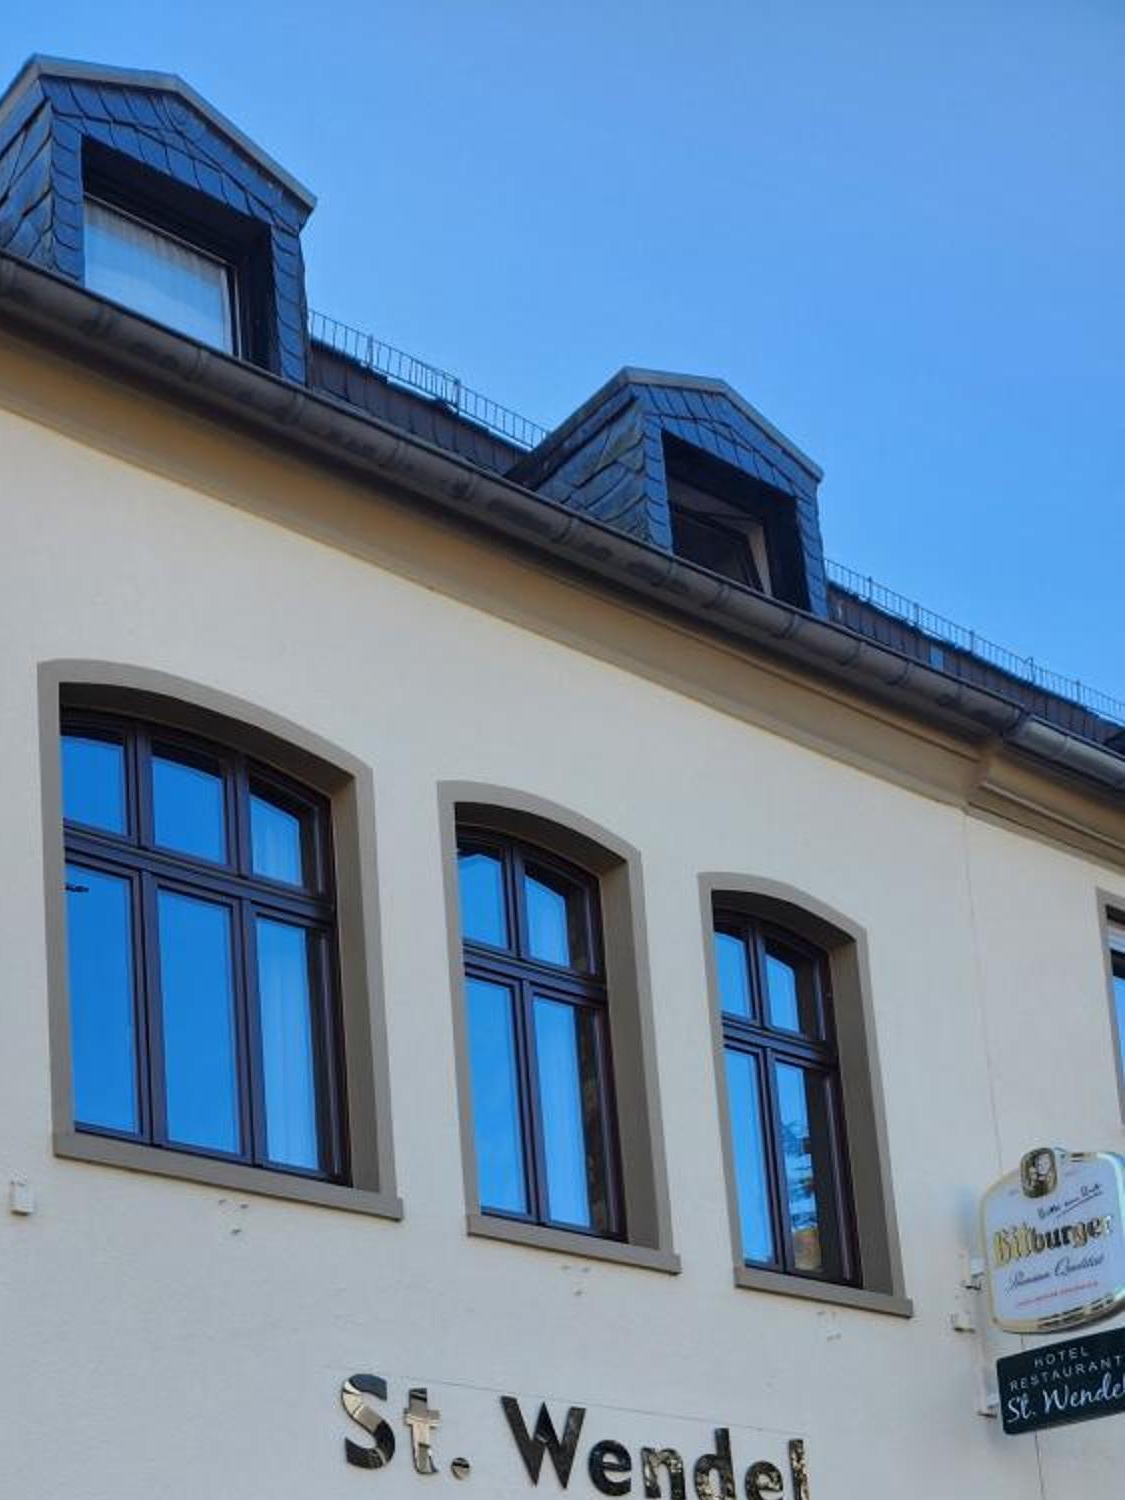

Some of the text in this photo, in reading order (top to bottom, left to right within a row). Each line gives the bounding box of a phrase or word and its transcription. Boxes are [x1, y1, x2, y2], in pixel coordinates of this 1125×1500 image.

[1009, 1355, 1123, 1392] RESTAURANT
[1034, 1346, 1088, 1368] HOTEL
[342, 1373, 472, 1481] St.
